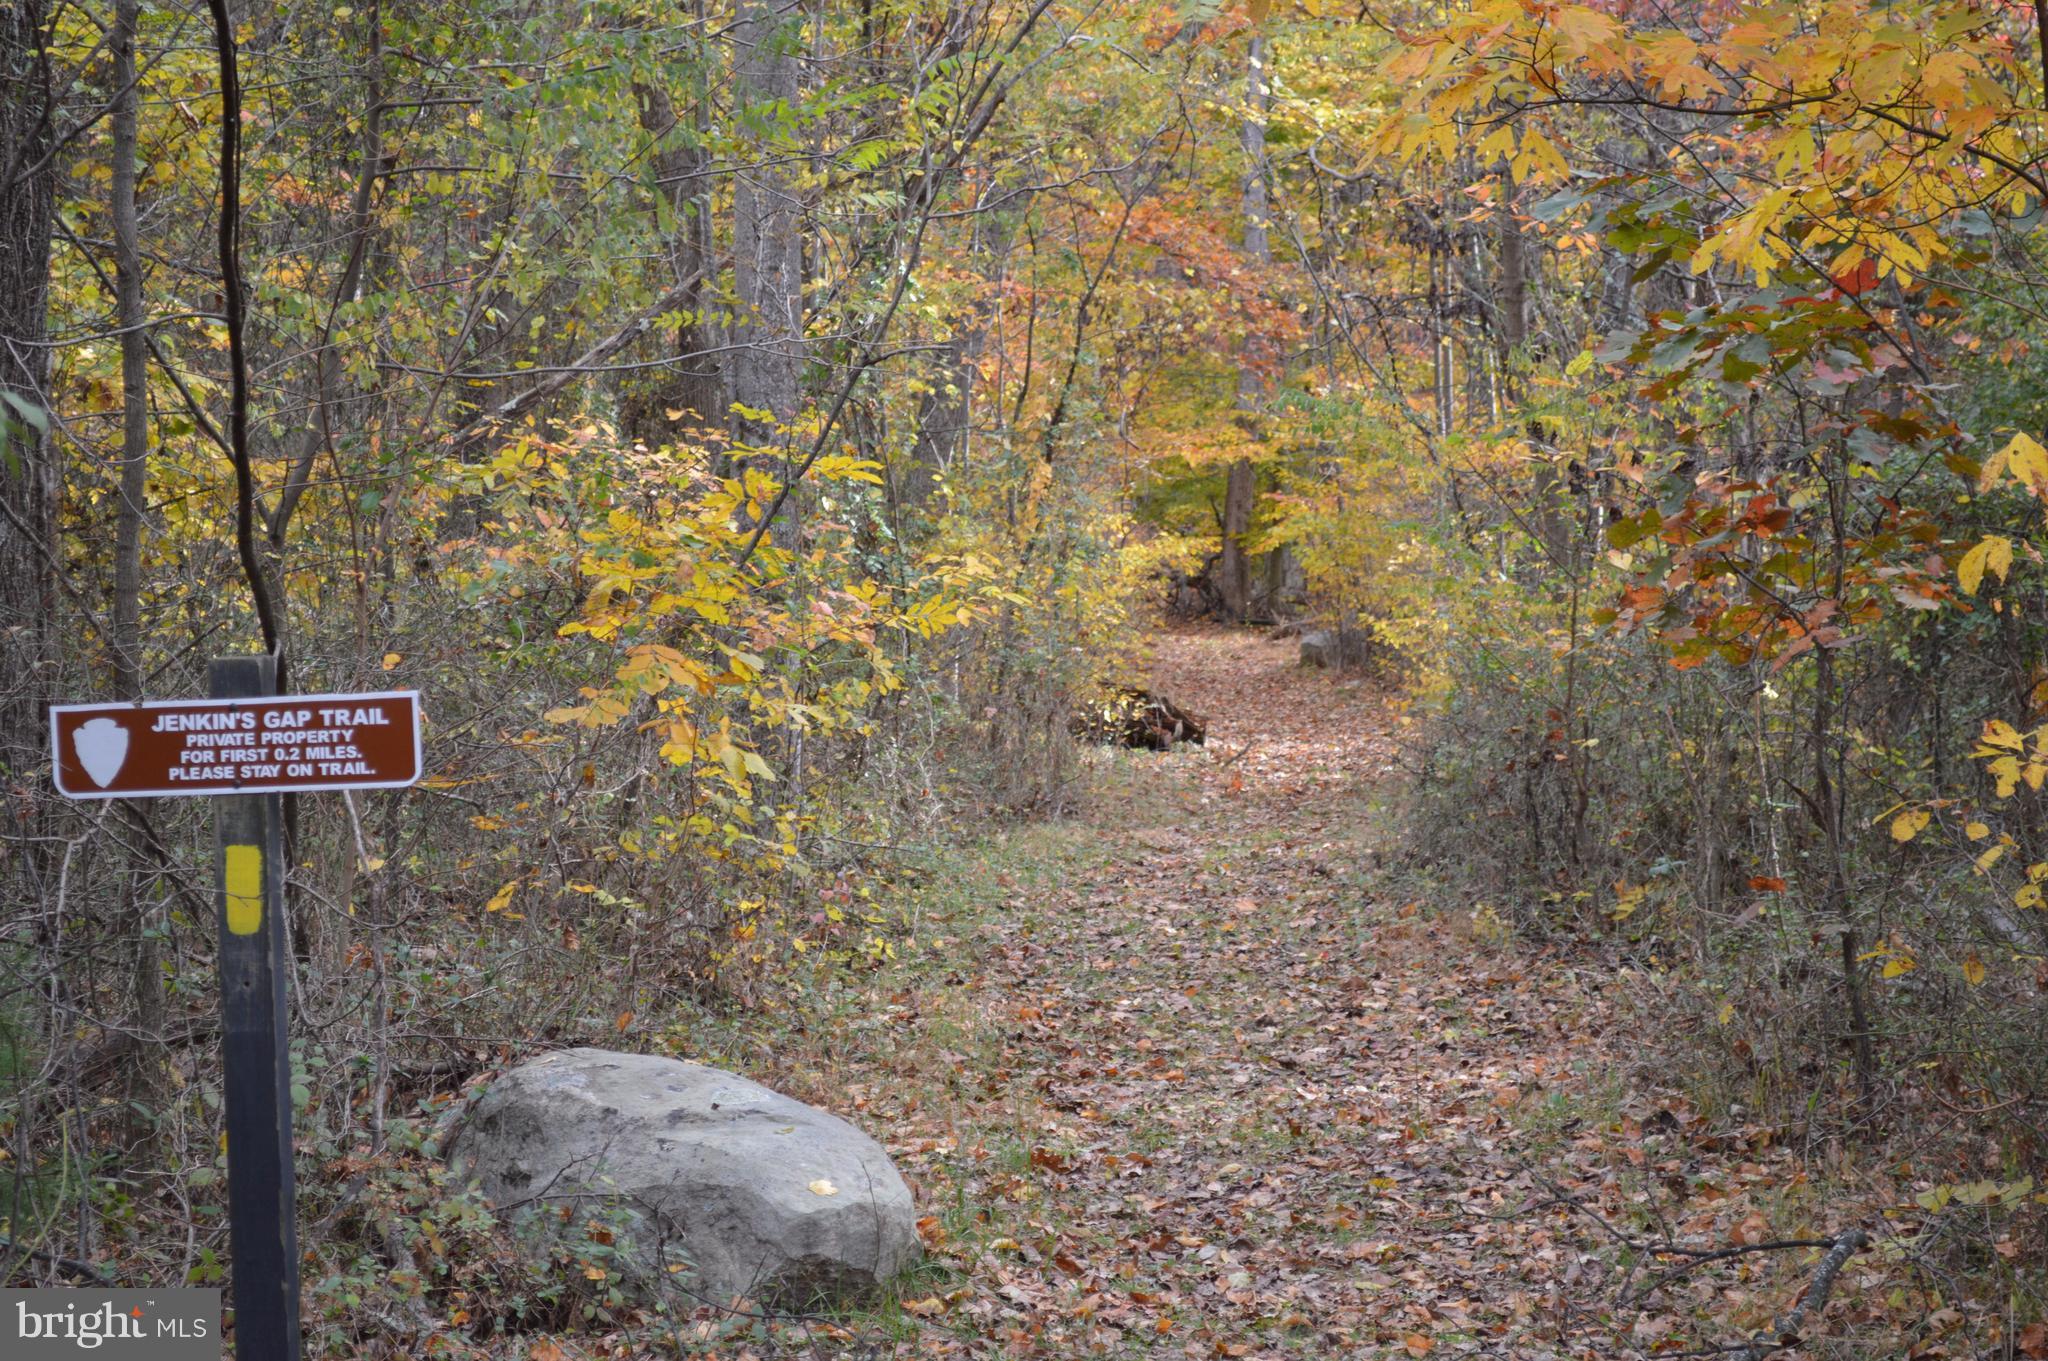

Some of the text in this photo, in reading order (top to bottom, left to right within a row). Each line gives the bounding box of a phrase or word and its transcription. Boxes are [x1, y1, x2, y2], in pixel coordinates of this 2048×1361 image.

[151, 708, 389, 733] JENKIN'S GAP TRAIL
[186, 729, 354, 748] PRIVATE PROPERTY
[180, 745, 362, 764] FOR FIRST 0.2 MILES.
[169, 761, 376, 781] PLEASE STAY ON TRAIL.
